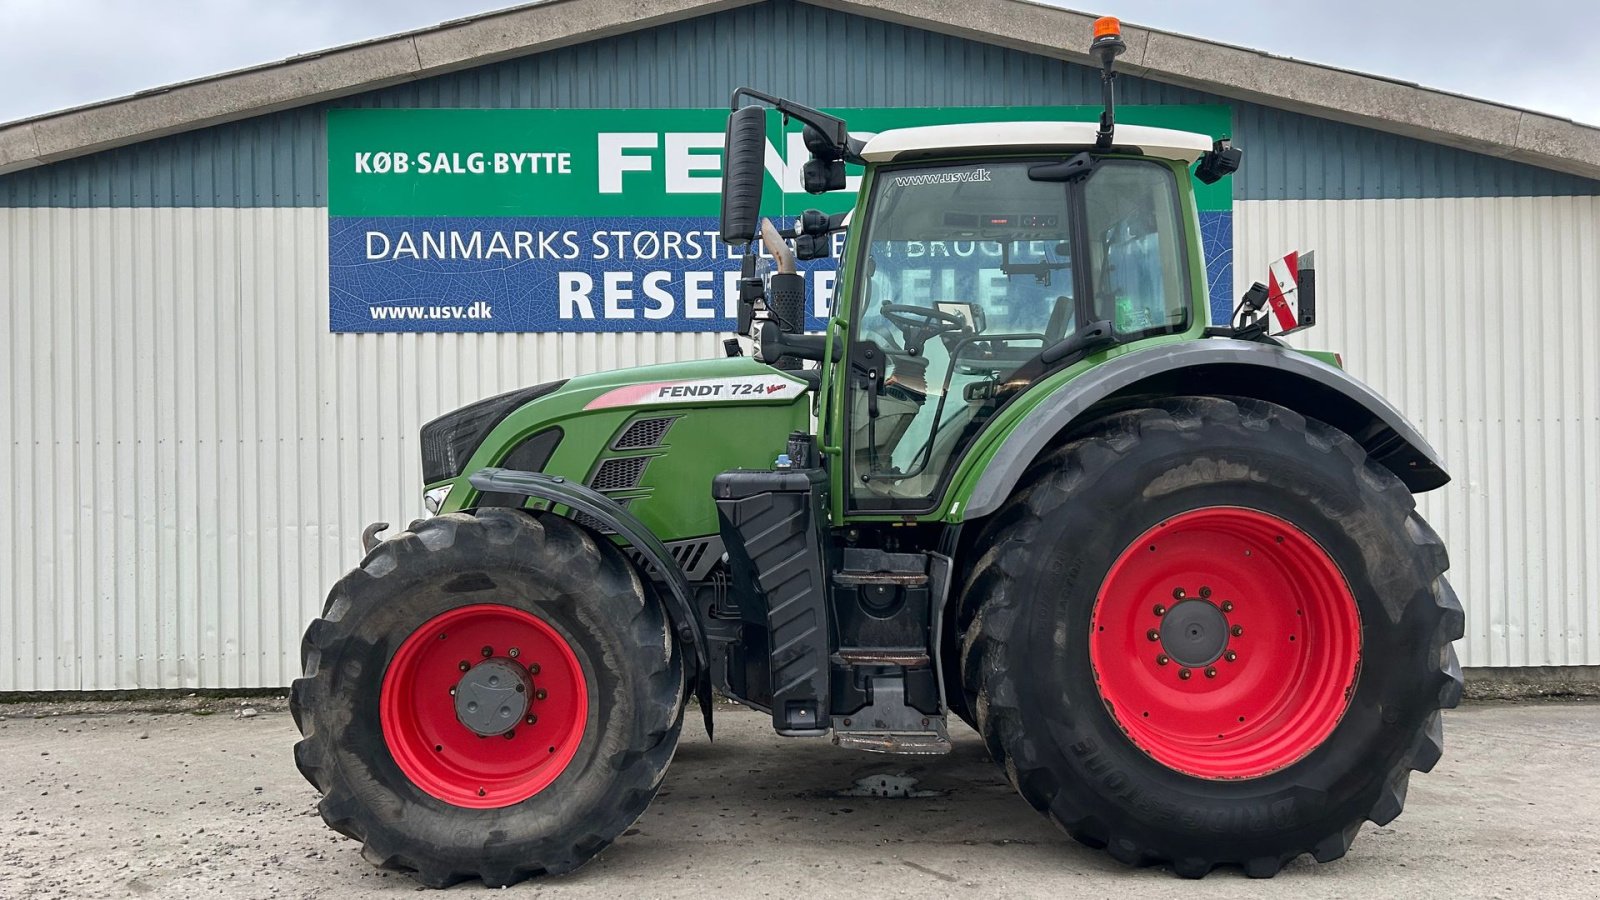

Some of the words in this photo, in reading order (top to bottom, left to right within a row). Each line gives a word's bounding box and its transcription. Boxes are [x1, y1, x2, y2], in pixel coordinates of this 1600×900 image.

[597, 131, 880, 194] FEN
[895, 168, 991, 187] www.usv.dk
[365, 230, 579, 260] DANMARKS
[369, 301, 493, 320] www.usv.dk
[658, 384, 725, 398] FENDT
[731, 383, 765, 395] 724
